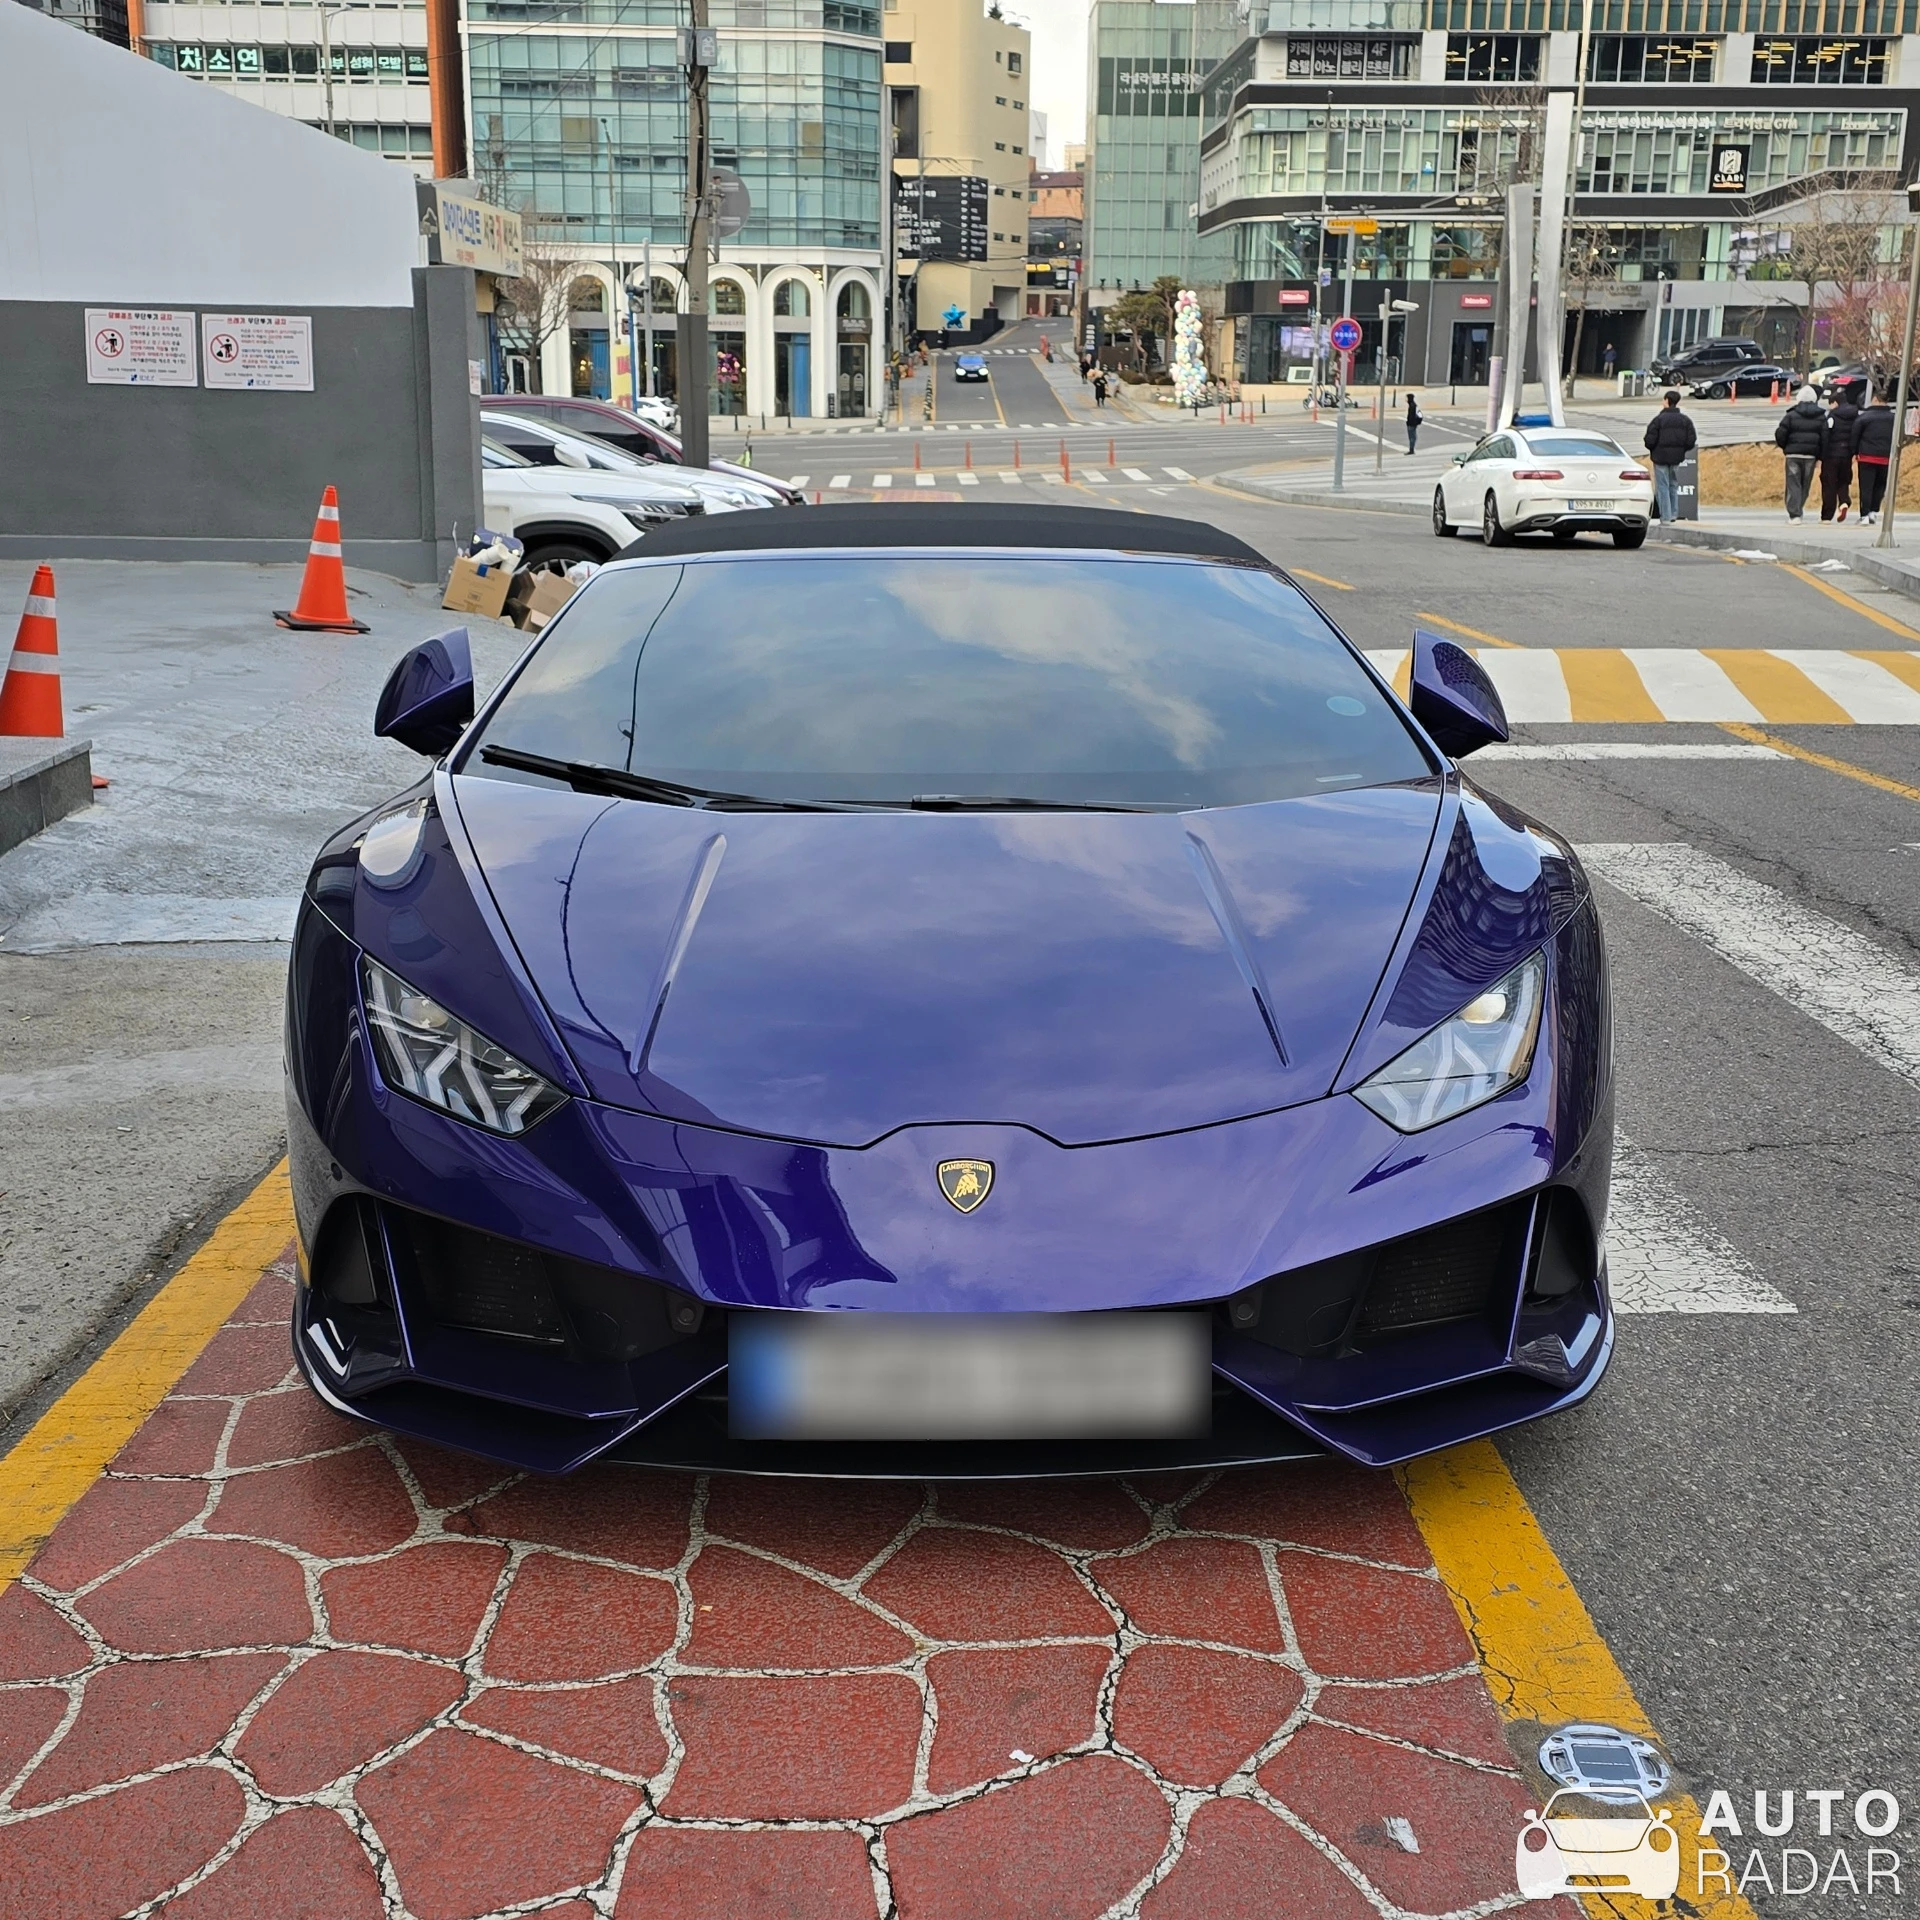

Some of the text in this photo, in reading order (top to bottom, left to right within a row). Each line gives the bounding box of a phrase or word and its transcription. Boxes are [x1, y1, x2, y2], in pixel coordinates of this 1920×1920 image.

[1289, 41, 1388, 56] 카페 식사 음료 4F
[180, 47, 258, 71] 차소연
[378, 56, 401, 69] 모발
[1288, 60, 1310, 74] 호텔
